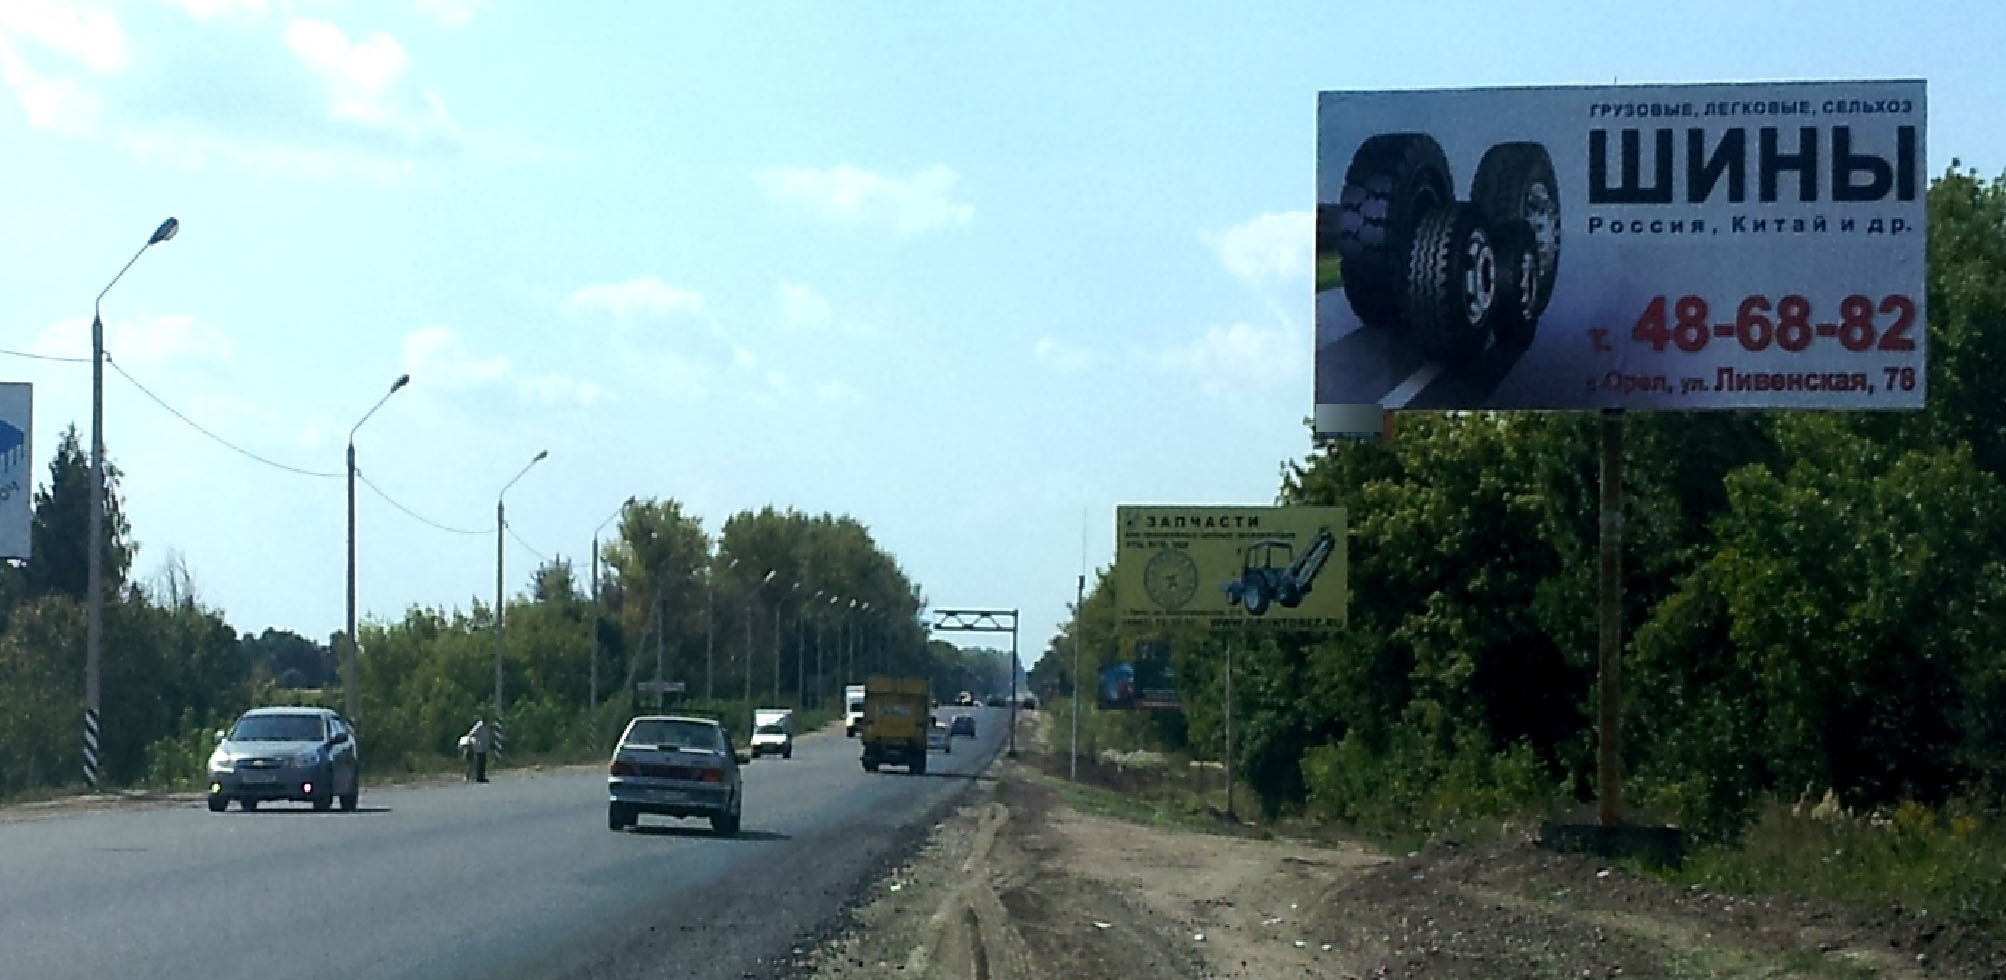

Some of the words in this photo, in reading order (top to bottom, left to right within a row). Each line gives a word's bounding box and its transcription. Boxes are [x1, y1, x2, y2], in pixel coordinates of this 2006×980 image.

[1589, 103, 1698, 118] ГРУЗОВЫЕ,
[1704, 101, 1816, 117] ЛЕГКОВЫЕ,
[1822, 99, 1912, 115] СЕЛЬХОЗ
[1588, 125, 1916, 204] ШИНЫ
[1588, 216, 1717, 235] Россия,
[1731, 215, 1827, 233] Китай
[1840, 218, 1854, 233] и
[1866, 218, 1912, 236] др.
[1632, 294, 1916, 352] 48-68-82
[1713, 366, 1874, 395] Ливенская,
[1882, 367, 1916, 392] 78
[1146, 515, 1259, 529] ЗАПЧАСТИ
